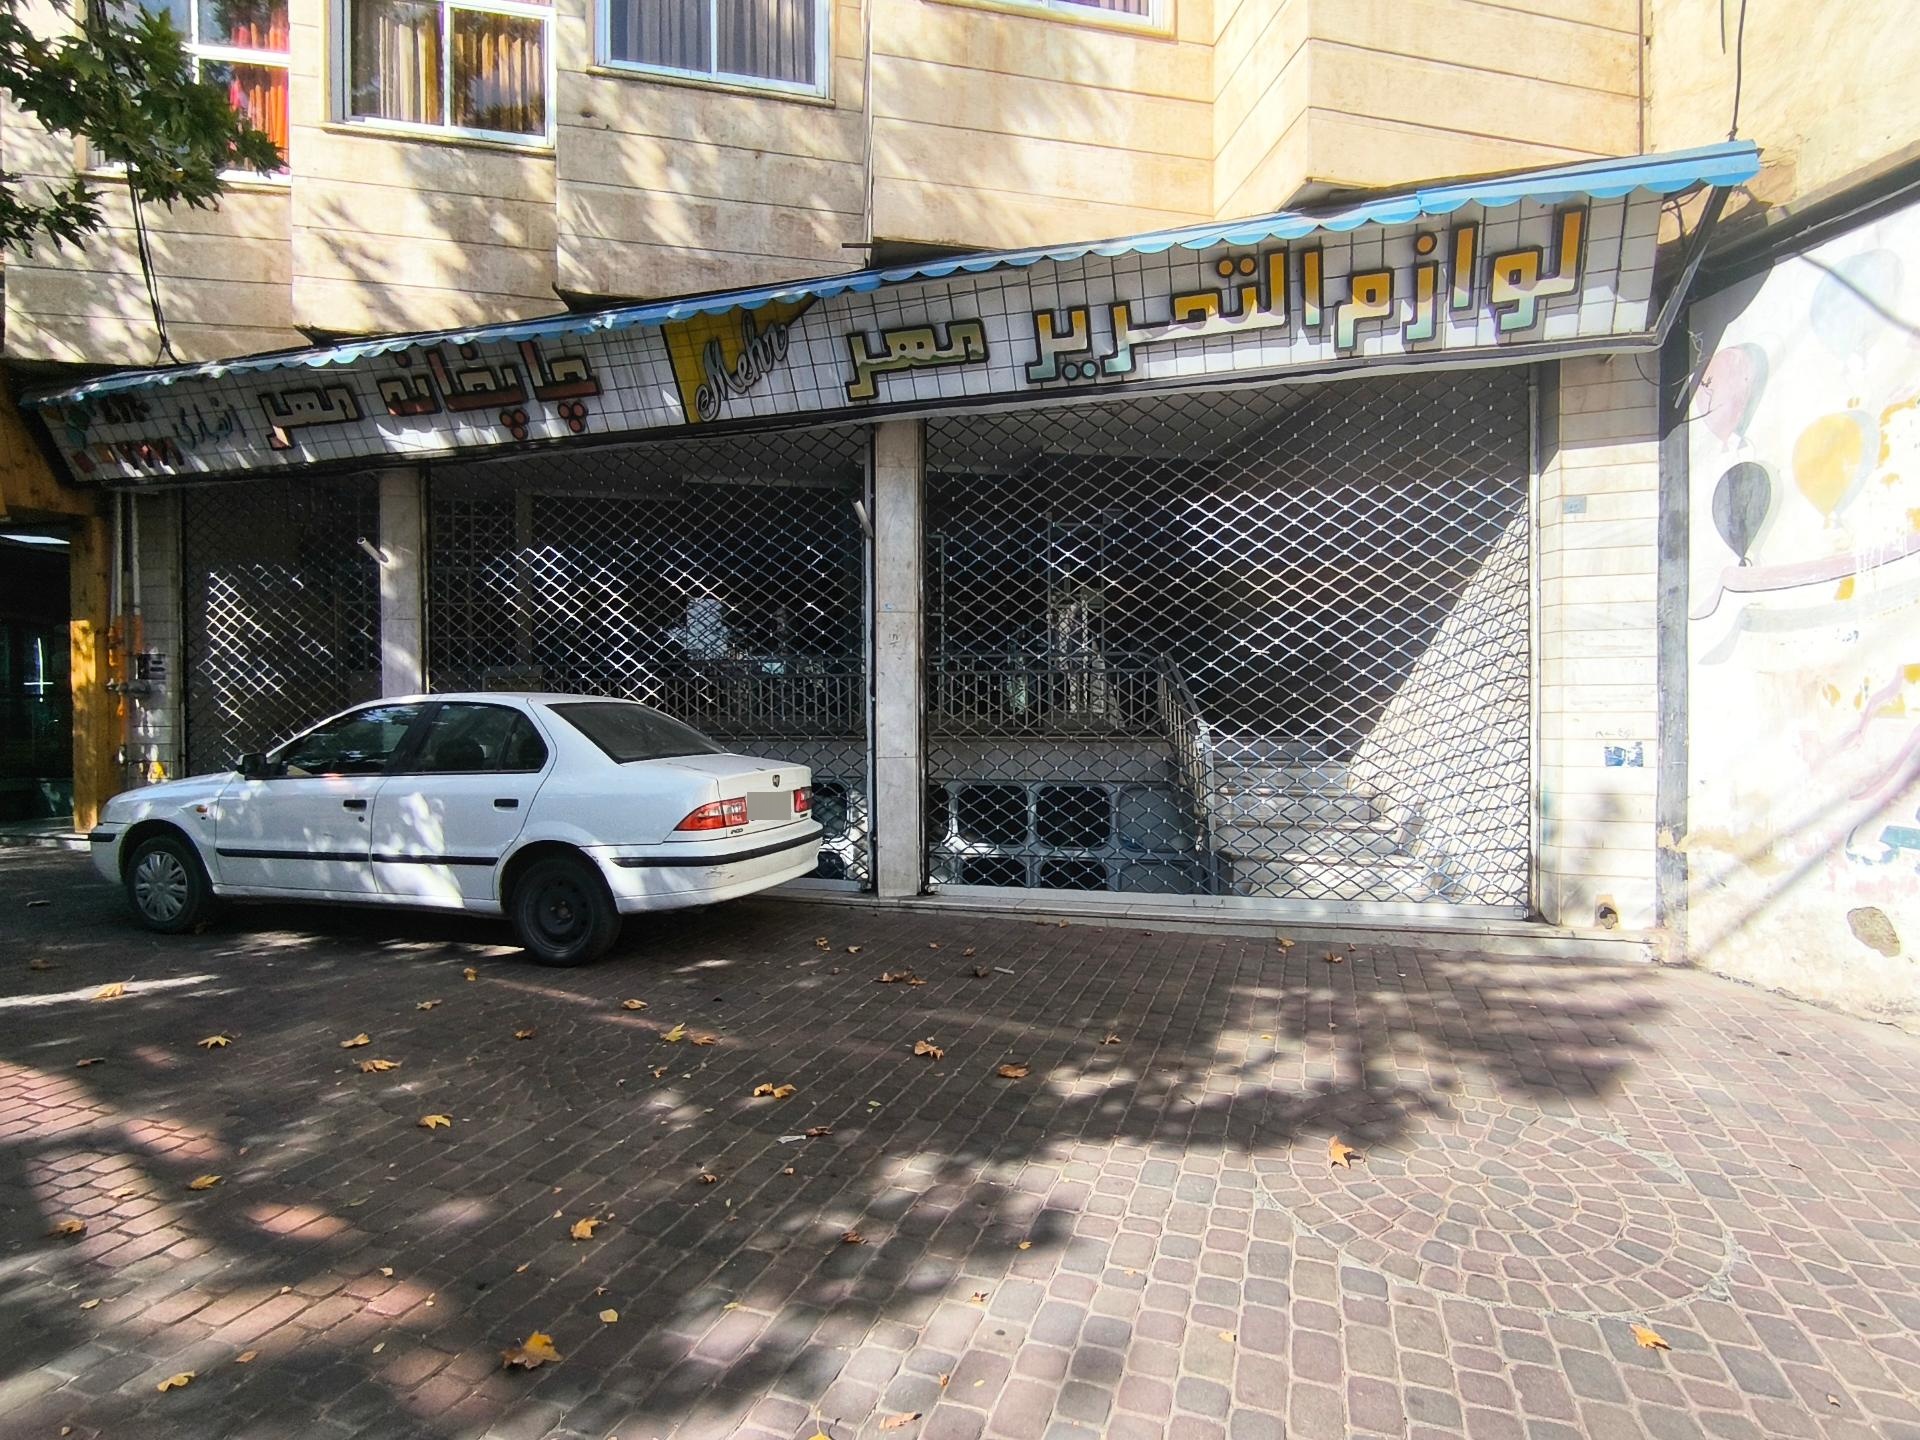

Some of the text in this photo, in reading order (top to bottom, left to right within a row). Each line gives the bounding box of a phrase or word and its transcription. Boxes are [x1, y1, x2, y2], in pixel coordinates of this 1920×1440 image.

[846, 204, 1587, 403] لوازم التحریر مهر
[257, 340, 604, 450] چاپخانه مهر
[696, 309, 789, 422] Mehr
